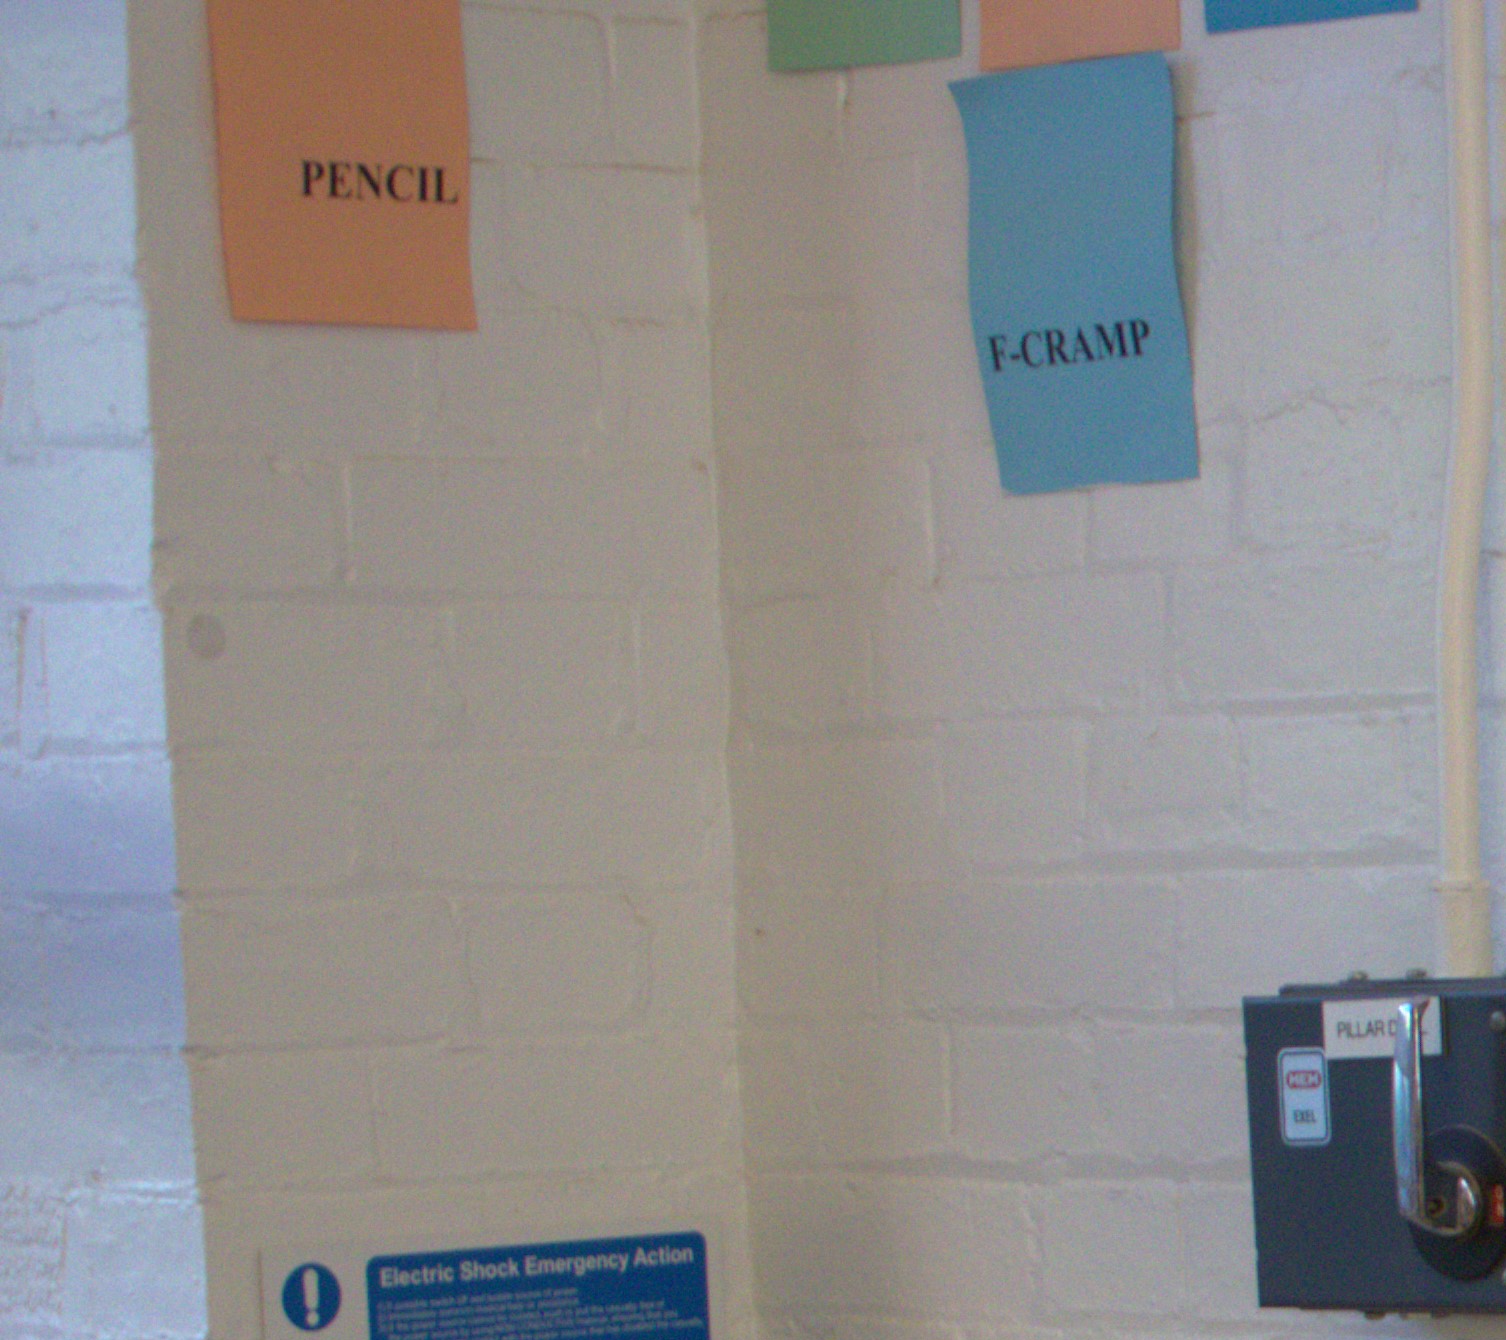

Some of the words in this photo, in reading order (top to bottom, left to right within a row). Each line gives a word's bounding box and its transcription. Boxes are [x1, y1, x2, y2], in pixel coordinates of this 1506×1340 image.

[302, 160, 459, 204] PENCIL
[988, 317, 1150, 372] F-CRAMP
[1337, 1020, 1386, 1039] PILLAR
[380, 1265, 454, 1287] Electric
[459, 1258, 520, 1281] Shock
[524, 1251, 628, 1276] Emergency
[633, 1246, 694, 1266] Action
